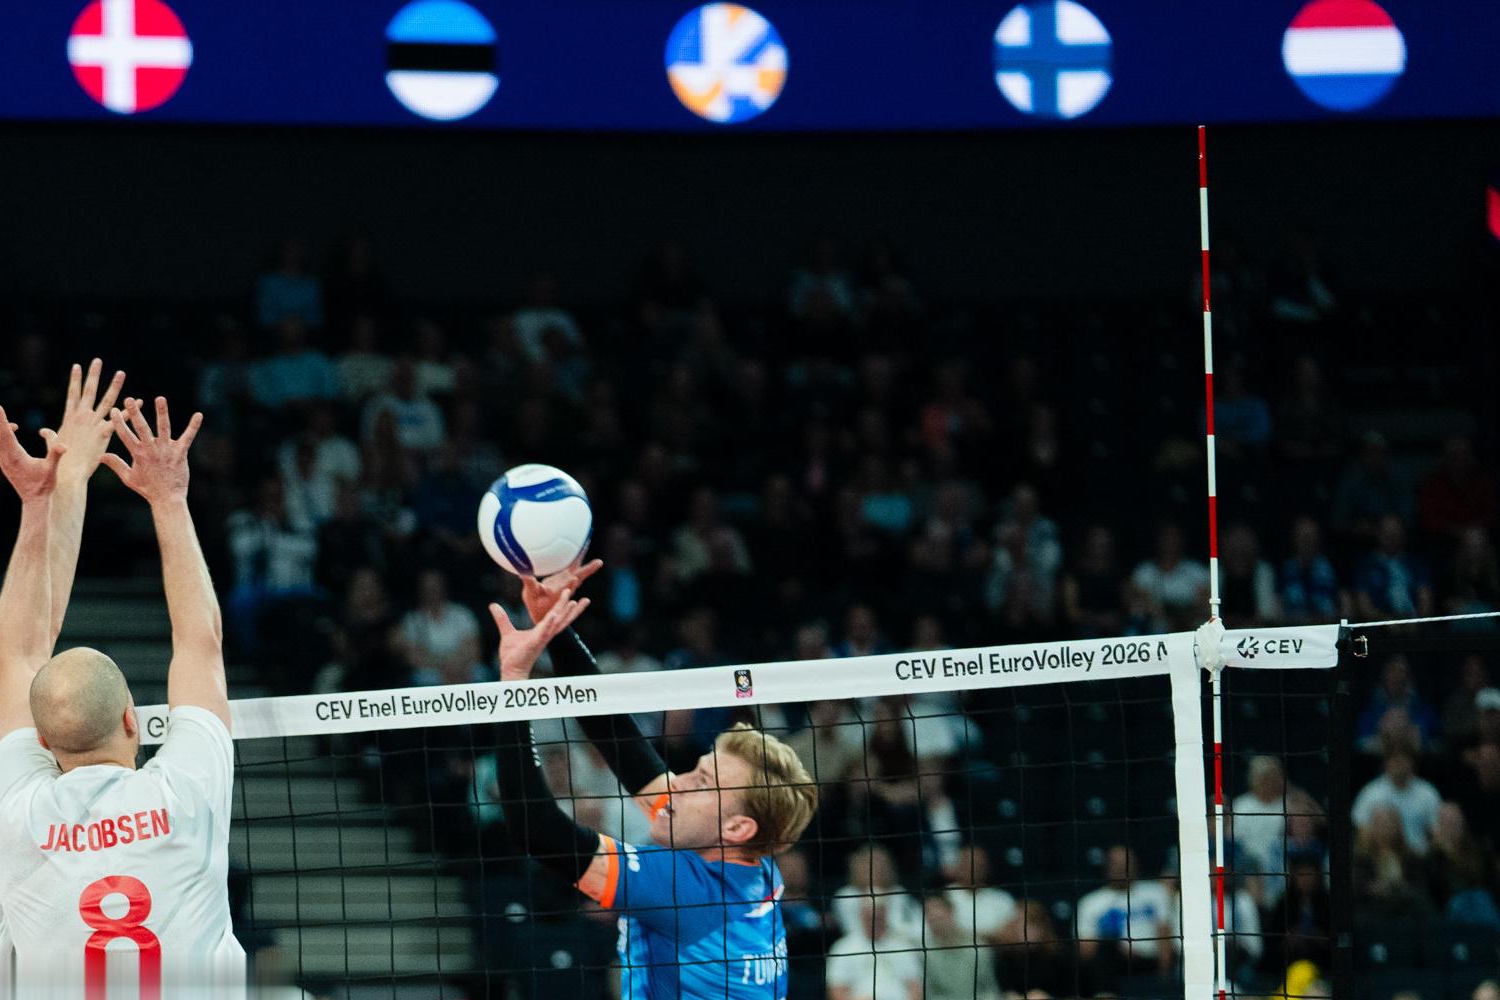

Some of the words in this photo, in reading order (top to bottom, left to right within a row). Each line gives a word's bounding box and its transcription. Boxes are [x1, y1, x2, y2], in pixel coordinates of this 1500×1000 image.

[895, 657, 936, 680] CEV
[942, 653, 983, 678] Enel
[990, 646, 1095, 674] EuroVolley
[1101, 642, 1150, 665] 2026
[1264, 638, 1303, 654] CEV
[315, 699, 354, 721] CEV
[358, 695, 397, 718] Enel
[402, 690, 498, 715] EuroVolley
[503, 686, 549, 708] 2026
[554, 684, 597, 705] Men
[40, 808, 171, 853] JACOBSEN
